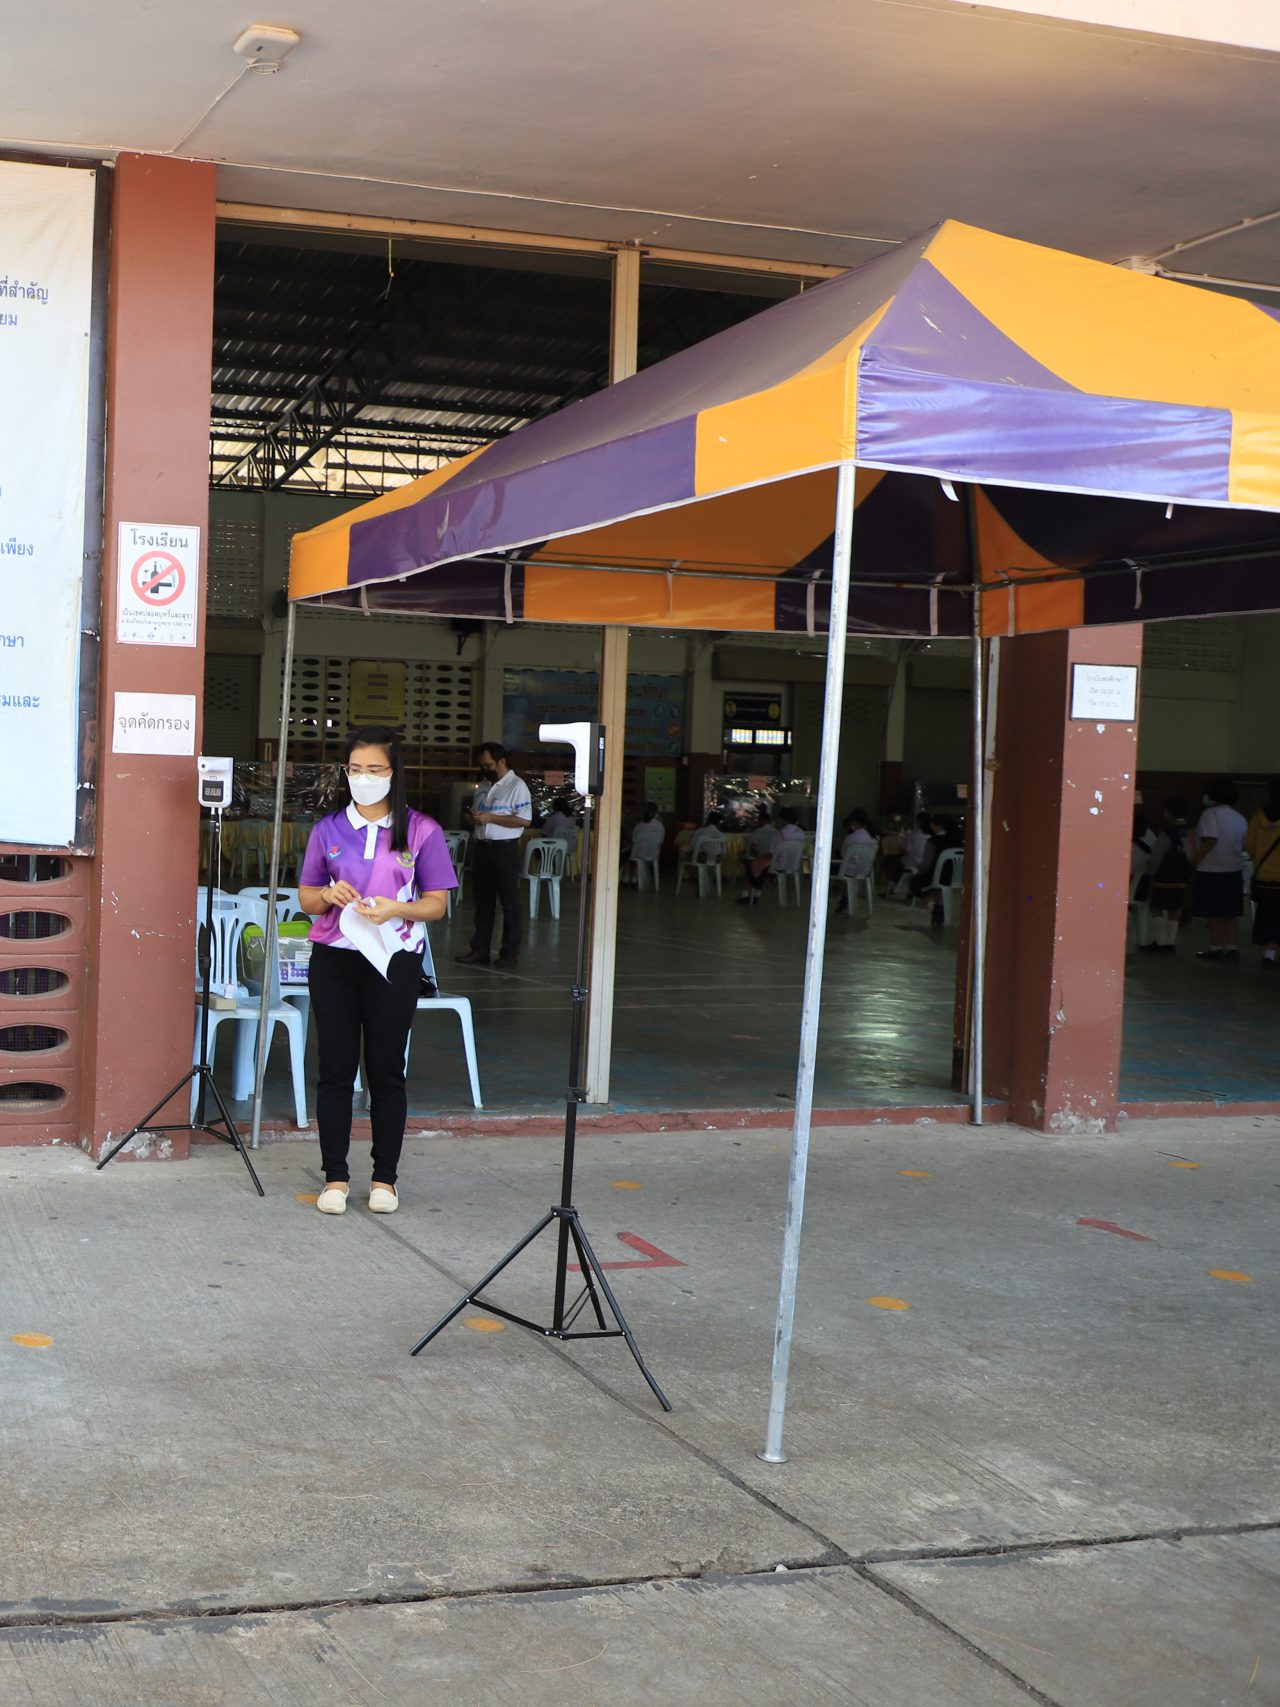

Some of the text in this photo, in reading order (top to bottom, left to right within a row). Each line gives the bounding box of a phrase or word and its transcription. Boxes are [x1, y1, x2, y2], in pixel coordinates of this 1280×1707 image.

[130, 528, 189, 549] โรงเรียน
[118, 712, 190, 734] จุดคัดกรอง
